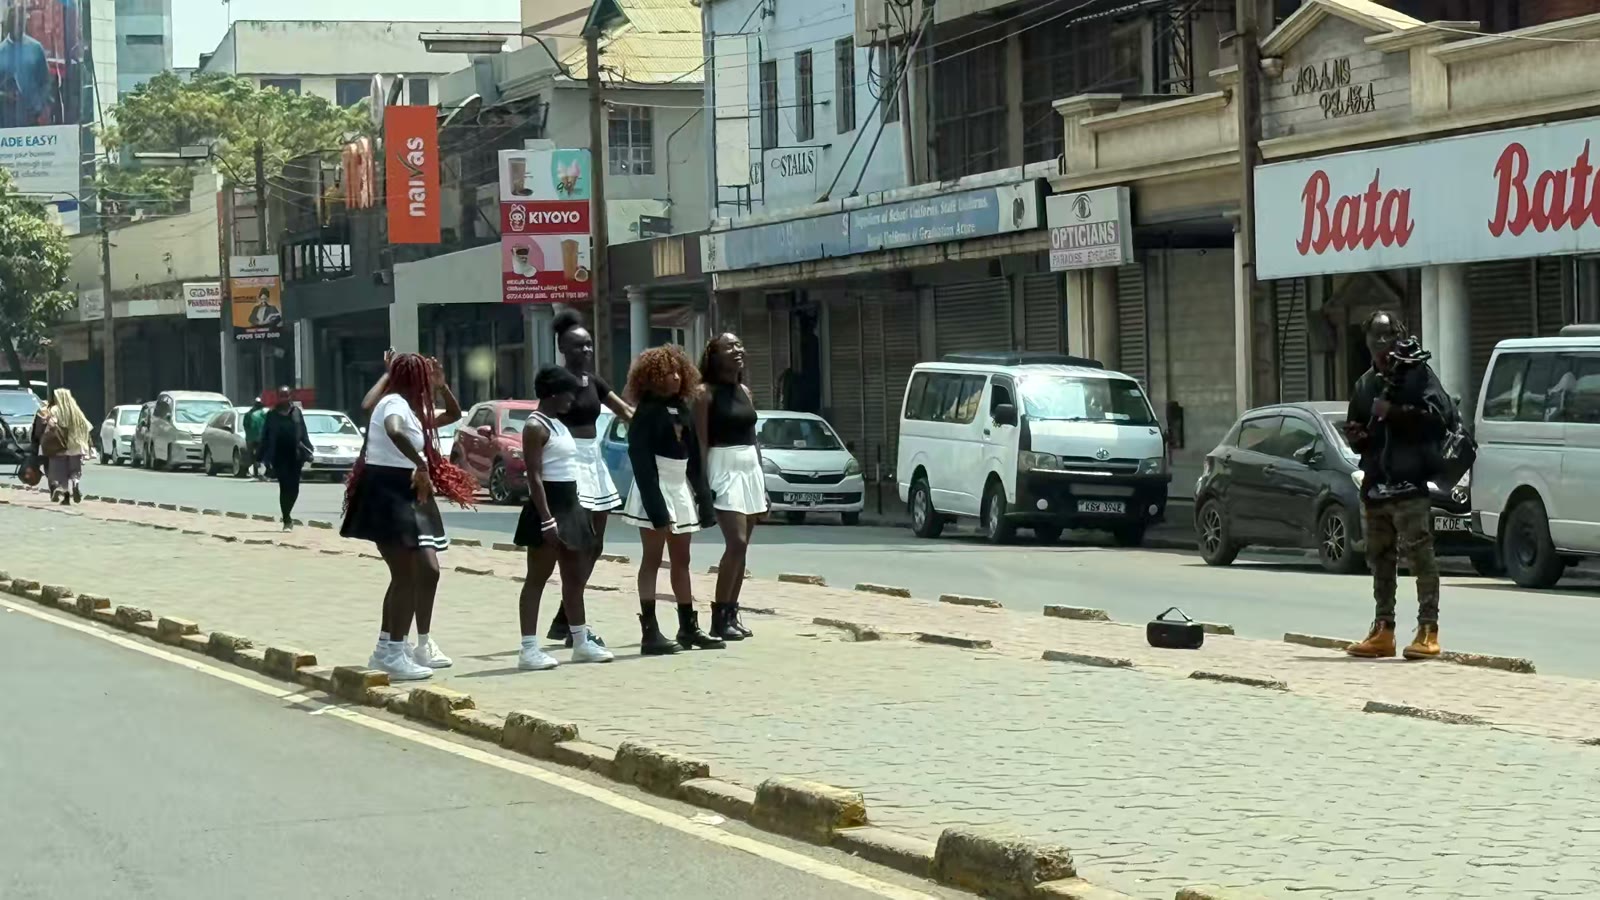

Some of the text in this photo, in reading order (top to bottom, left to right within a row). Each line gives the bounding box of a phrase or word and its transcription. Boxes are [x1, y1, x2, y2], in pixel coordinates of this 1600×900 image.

[1292, 58, 1351, 96] ADAMS
[1319, 82, 1376, 119] PLAZA
[25, 134, 57, 147] EASY!
[398, 136, 427, 217] naivas
[780, 150, 814, 178] STALLS
[1488, 138, 1600, 238] Bat
[528, 210, 580, 224] KIYOYO
[1296, 168, 1415, 256] Bata
[1051, 221, 1116, 249] OPTICIANS
[1442, 519, 1460, 530] KDE
